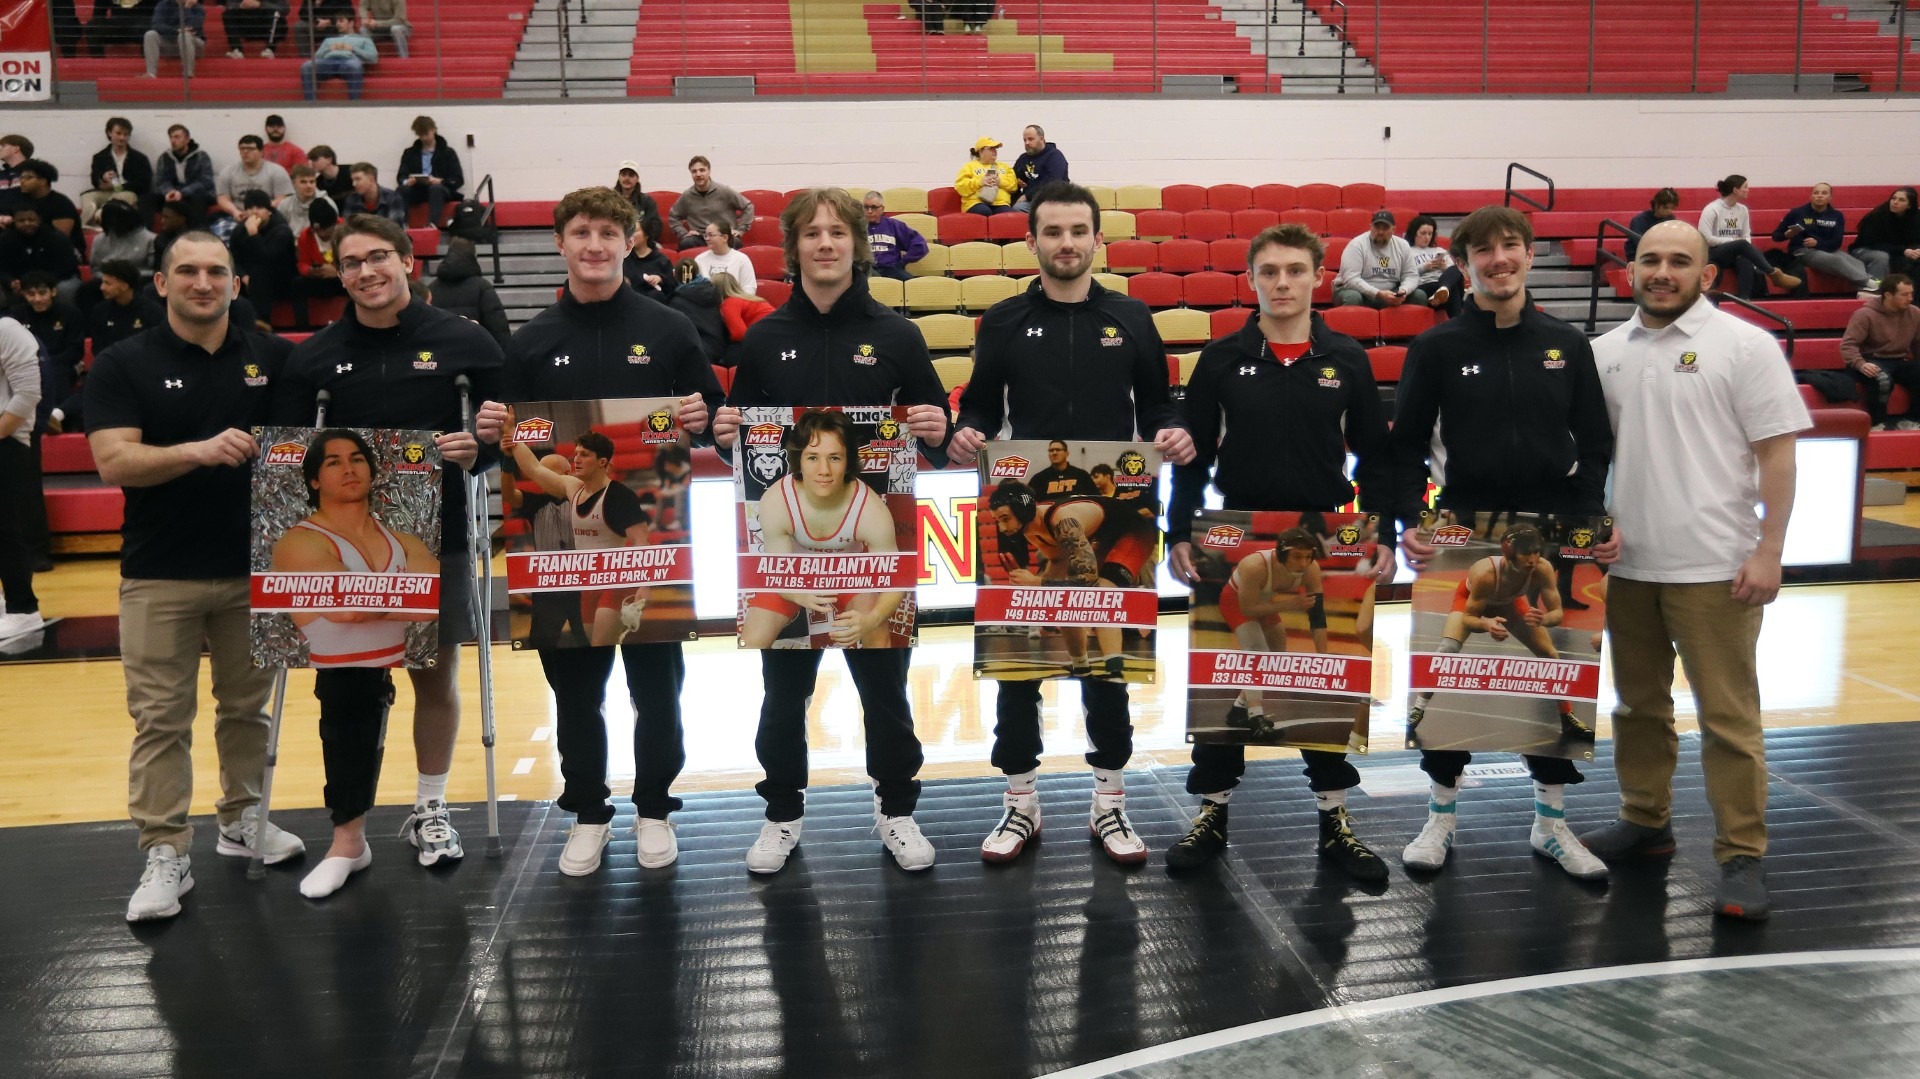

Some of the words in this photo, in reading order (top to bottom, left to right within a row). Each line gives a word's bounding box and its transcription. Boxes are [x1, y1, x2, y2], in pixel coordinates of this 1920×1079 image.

[516, 429, 549, 440] MAC
[748, 433, 780, 443] MAC
[870, 440, 906, 448] KING'S
[268, 453, 303, 463] MAC
[993, 467, 1025, 477] MAC
[1207, 536, 1238, 546] MAC
[1434, 535, 1467, 545] MAC
[528, 554, 598, 573] FRANKIE
[601, 549, 677, 570] THEROUX
[757, 557, 796, 575] ALEX
[800, 556, 900, 575] BALLANTYNE
[538, 575, 557, 586] 184
[589, 571, 617, 584] DEER
[620, 569, 651, 583] PARK,
[653, 568, 669, 580] NY
[765, 576, 783, 588] 174
[813, 576, 875, 588] LEVITTOWN,
[877, 575, 891, 587] PA
[262, 576, 334, 594] CONNOR
[338, 576, 433, 595] WROBLESKI
[291, 595, 311, 607] 197
[344, 595, 387, 608] EXETER,
[388, 596, 403, 607] PA
[1011, 590, 1066, 608] SHANE
[1067, 591, 1124, 609] KIBLER
[1005, 608, 1024, 620] 149
[1054, 610, 1111, 623] ABINGTON,
[1113, 611, 1127, 622] PA
[1215, 653, 1256, 671] COLE
[1257, 655, 1346, 676] ANDERSON
[1429, 657, 1499, 676] PATRICK
[1501, 660, 1580, 682] HORVATH
[1211, 672, 1230, 683] 133
[1262, 674, 1291, 686] TOMS
[1294, 675, 1328, 689] RIVER,
[1331, 678, 1347, 690] NJ
[1437, 675, 1456, 687] 125
[1488, 679, 1549, 693] BELVIDERE,
[1552, 683, 1569, 694] NJ
